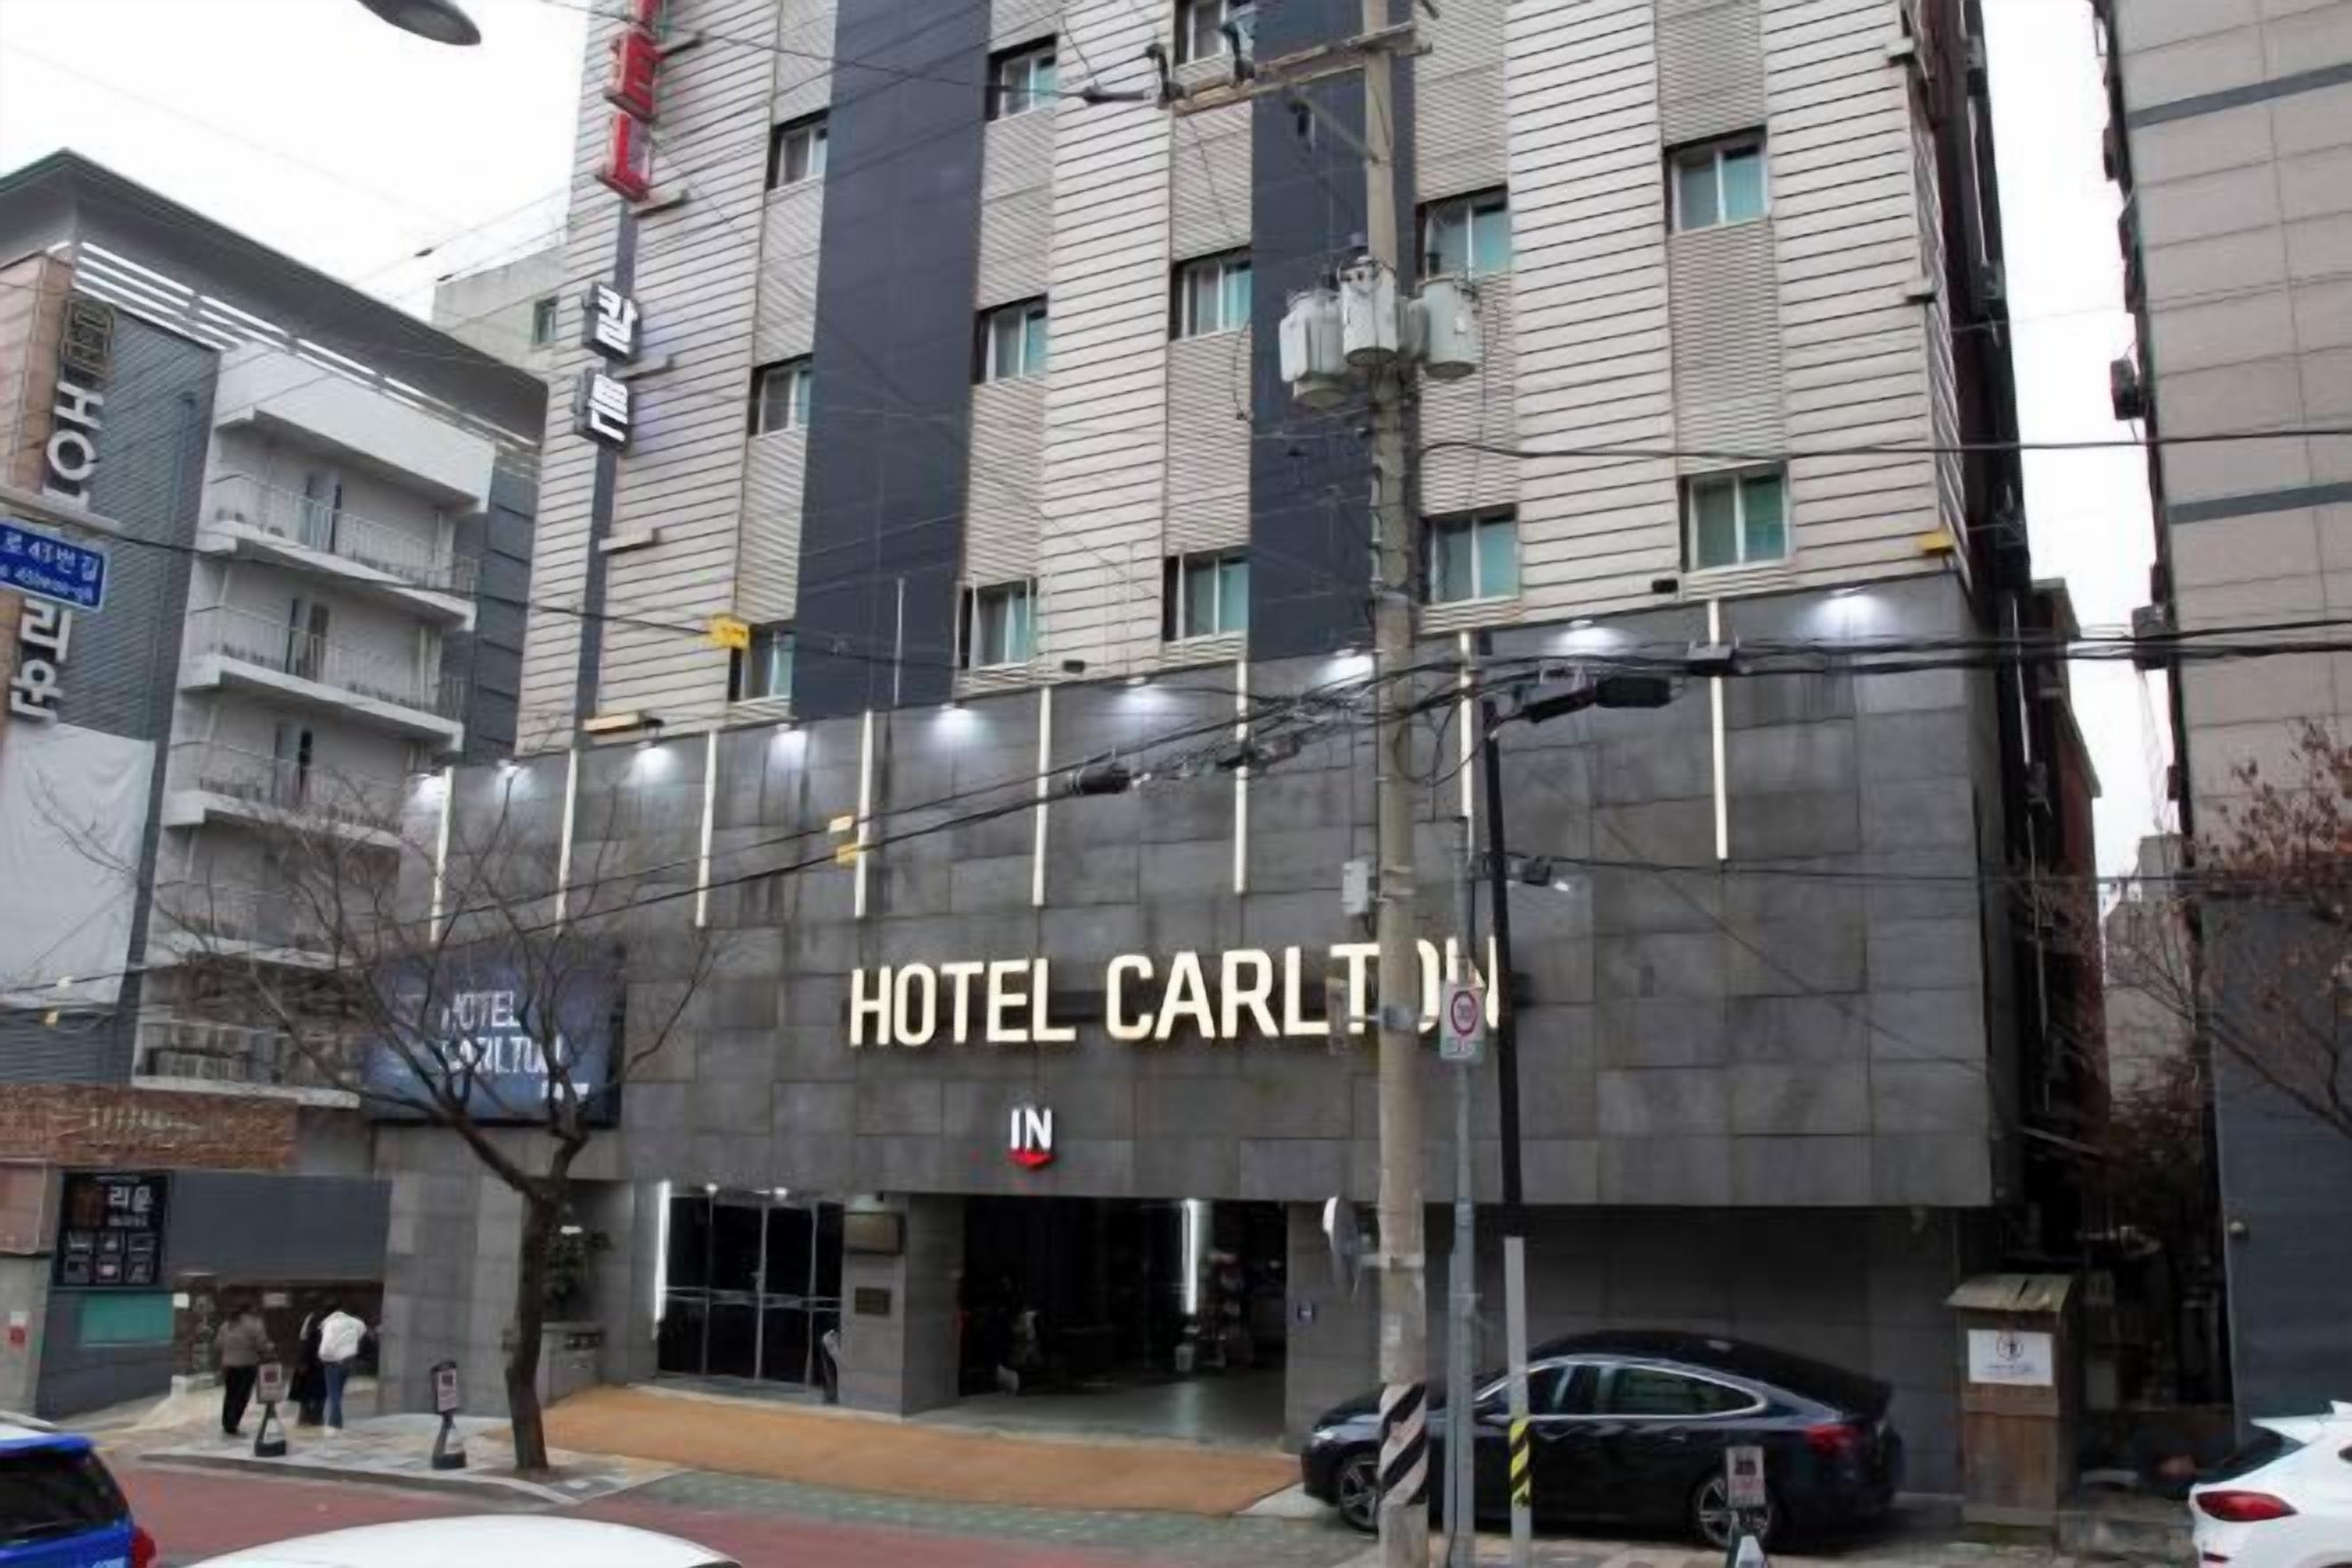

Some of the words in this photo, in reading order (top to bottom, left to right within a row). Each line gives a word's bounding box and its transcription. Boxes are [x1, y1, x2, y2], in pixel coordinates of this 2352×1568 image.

[588, 282, 639, 443] 칼튼
[850, 957, 1076, 1046] HOTEL
[1009, 1107, 1054, 1152] IN
